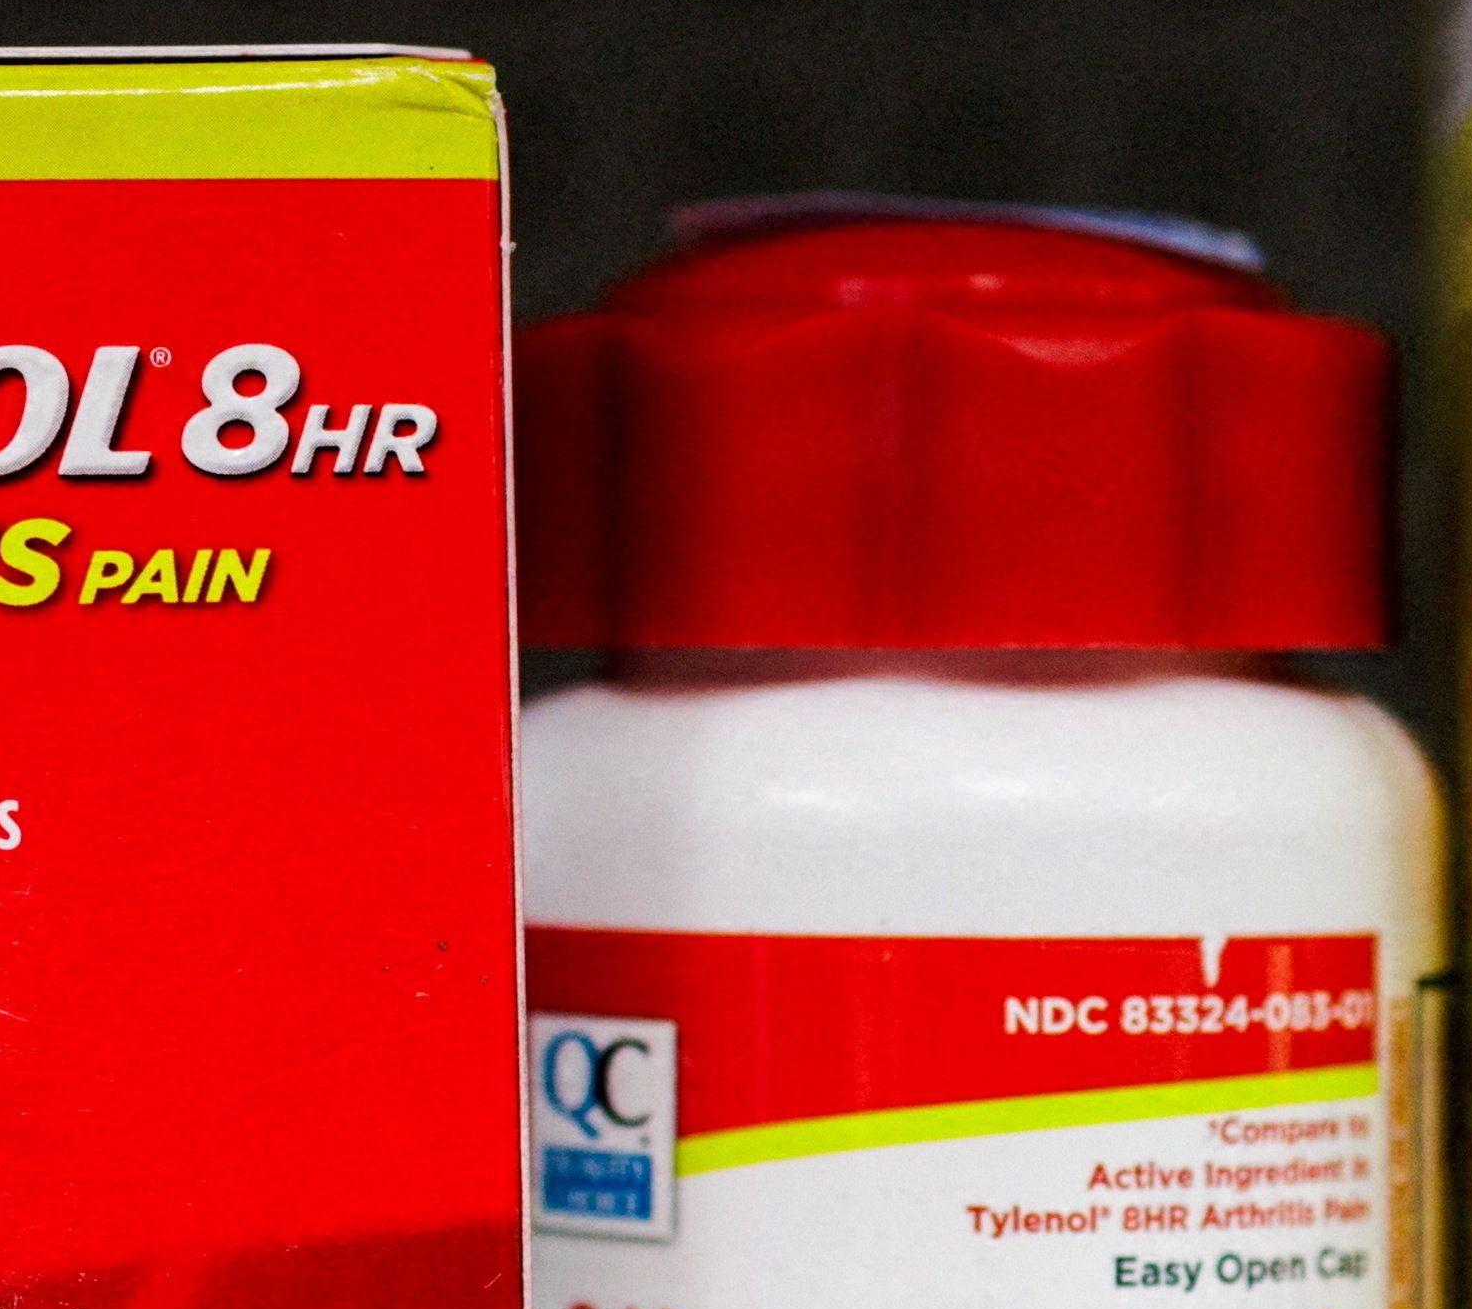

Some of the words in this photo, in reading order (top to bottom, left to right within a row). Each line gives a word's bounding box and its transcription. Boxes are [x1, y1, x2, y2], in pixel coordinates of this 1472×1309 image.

[182, 344, 437, 474] 8HR
[79, 549, 270, 604] PAIN
[1004, 996, 1109, 1035] NDC
[541, 1030, 651, 1139] QC
[1114, 1255, 1203, 1291] Easy
[1216, 1253, 1306, 1290] Open
